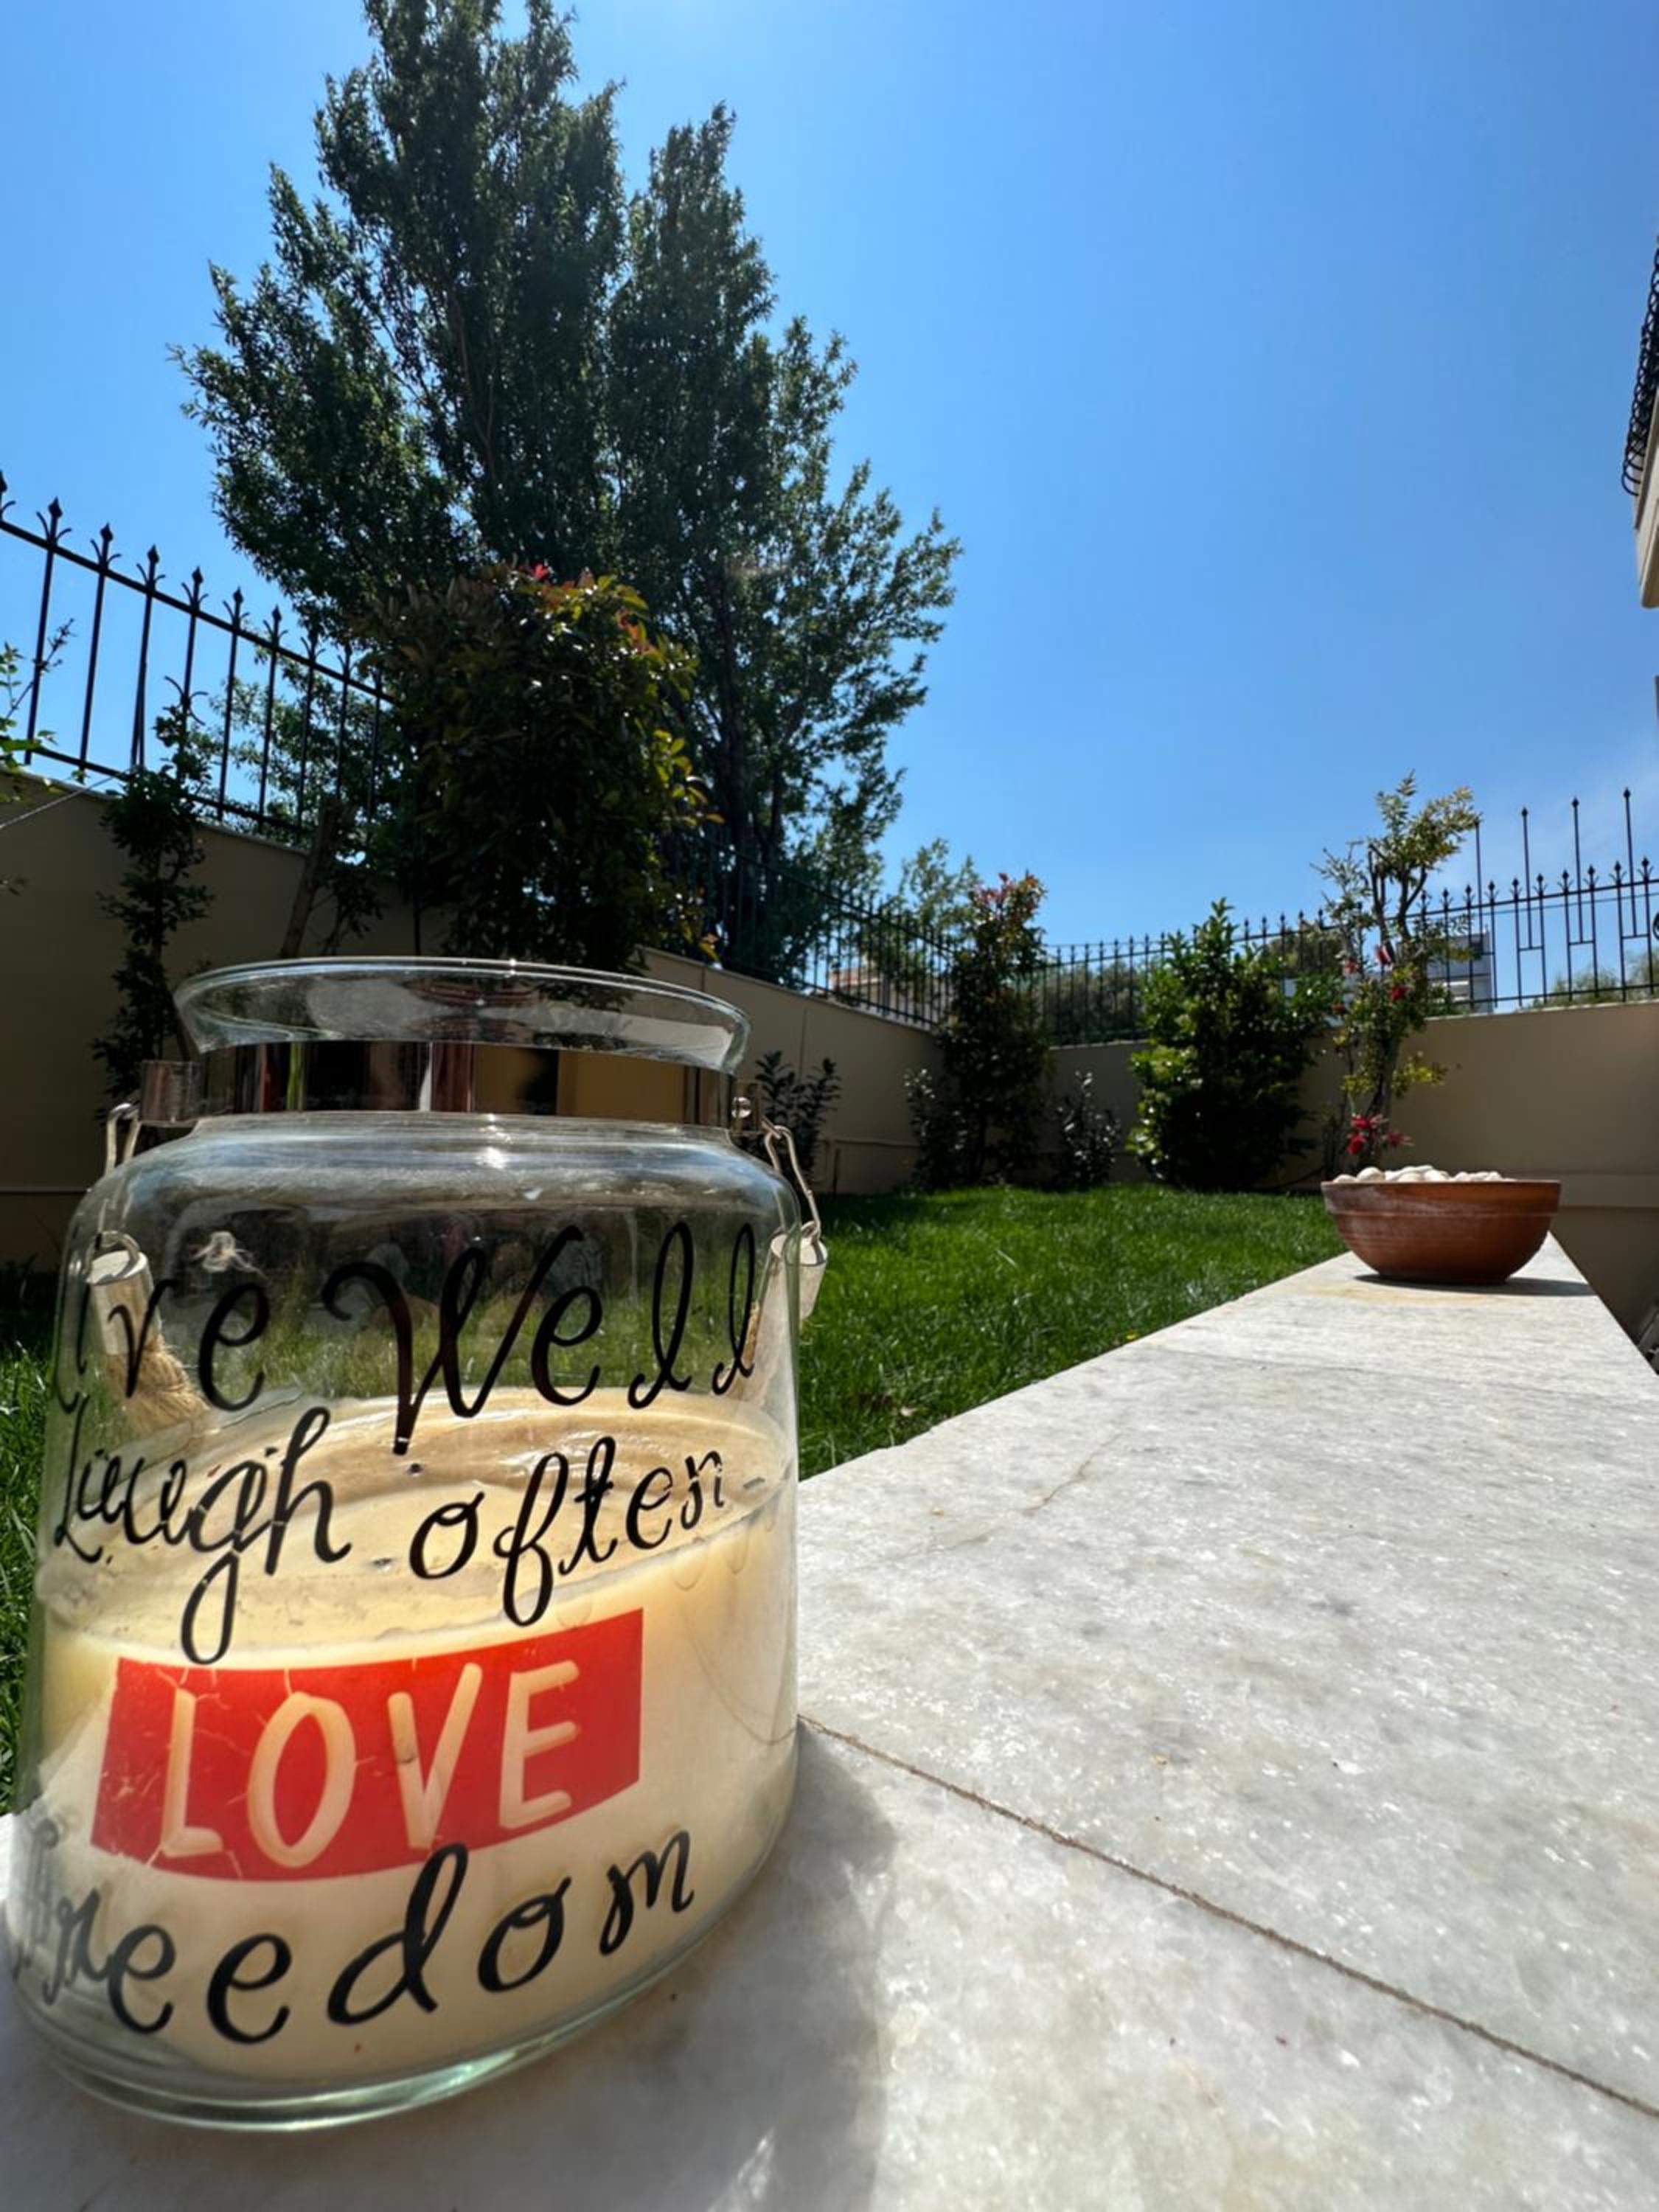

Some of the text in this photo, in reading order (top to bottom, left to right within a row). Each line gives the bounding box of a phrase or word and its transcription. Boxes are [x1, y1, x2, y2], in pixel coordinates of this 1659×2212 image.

[321, 1221, 757, 1455] Well
[408, 1436, 725, 1627] often
[162, 1661, 581, 1868] LOVE
